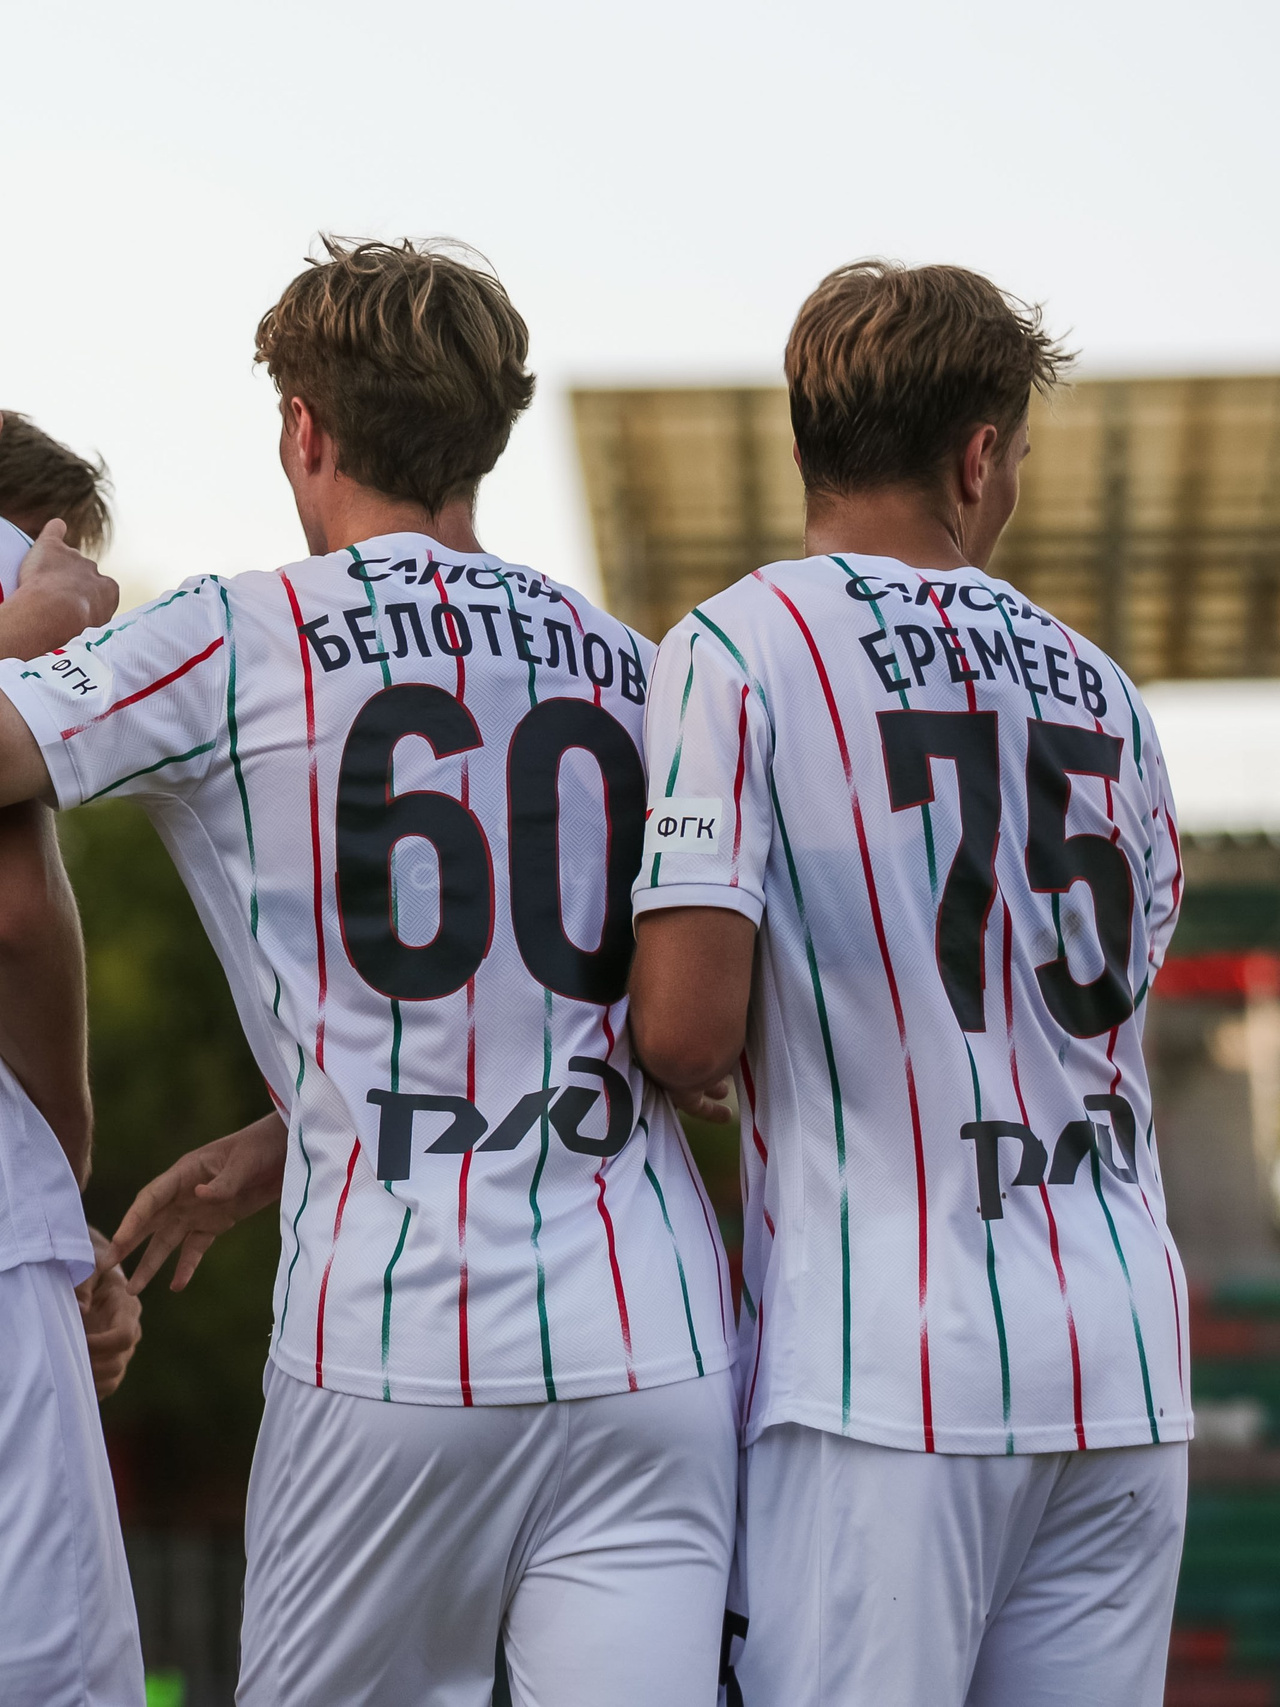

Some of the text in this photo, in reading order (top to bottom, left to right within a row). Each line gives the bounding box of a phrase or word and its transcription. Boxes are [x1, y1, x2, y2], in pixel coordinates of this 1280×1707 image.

[51, 659, 98, 695] ФГК
[298, 602, 646, 705] БЕЛОТЕЛОВ
[858, 624, 1107, 717] ЕРЕМЕЕВ
[335, 682, 647, 1003] 60
[657, 814, 714, 841] ФГК
[875, 709, 1133, 1039] 75
